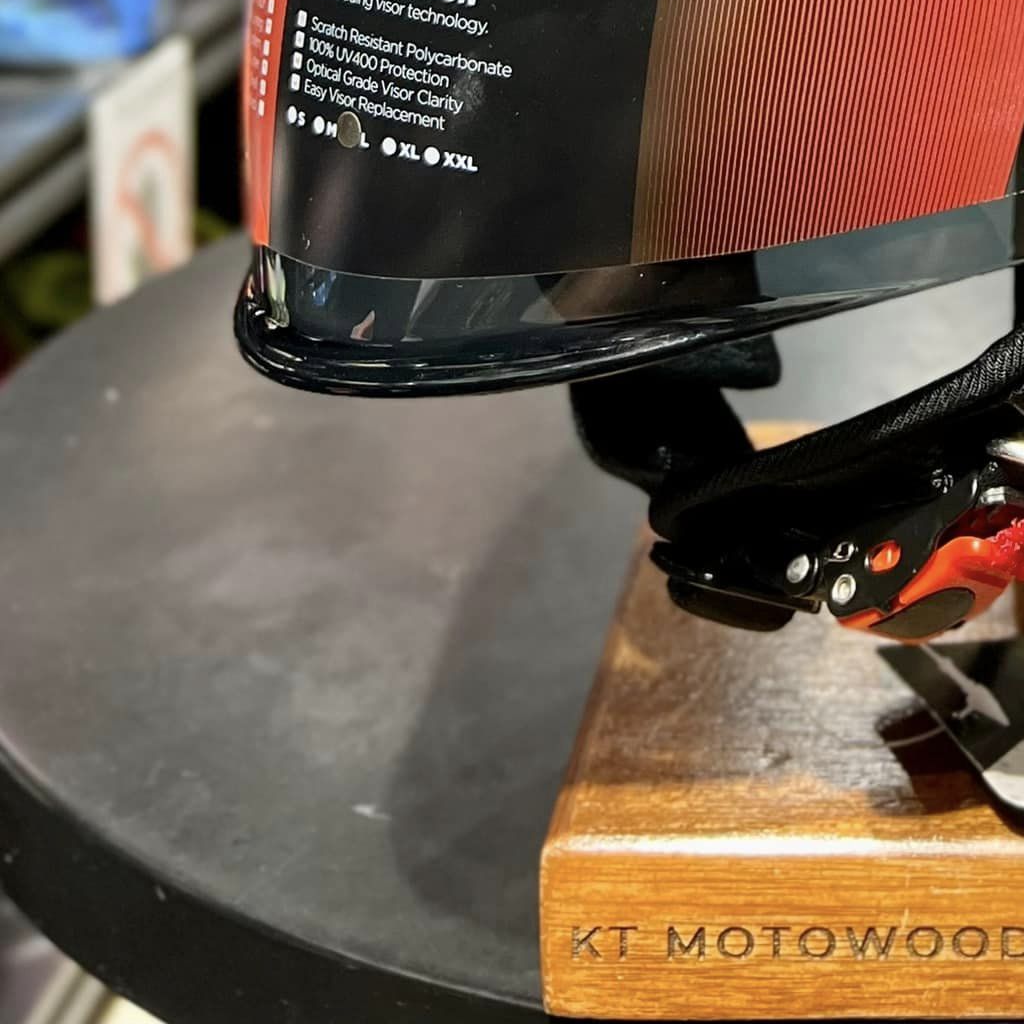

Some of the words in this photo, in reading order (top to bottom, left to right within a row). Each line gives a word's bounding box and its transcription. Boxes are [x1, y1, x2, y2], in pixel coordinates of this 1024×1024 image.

[408, 5, 489, 36] technology.
[309, 36, 335, 59] 100%
[336, 46, 379, 71] UV400
[380, 58, 450, 88] Protection
[311, 15, 348, 42] Scratch
[350, 27, 405, 57] Resistant
[406, 42, 513, 79] Polycarbonate
[304, 78, 328, 102] Easy
[329, 87, 358, 109] Visor
[358, 95, 446, 131] Replacement
[306, 58, 342, 82] Optical
[343, 70, 379, 94] Grade
[381, 80, 415, 102] Visor
[417, 89, 464, 115] Clarity
[398, 141, 421, 160] XL
[443, 151, 479, 172] XXL
[570, 925, 638, 961] KT
